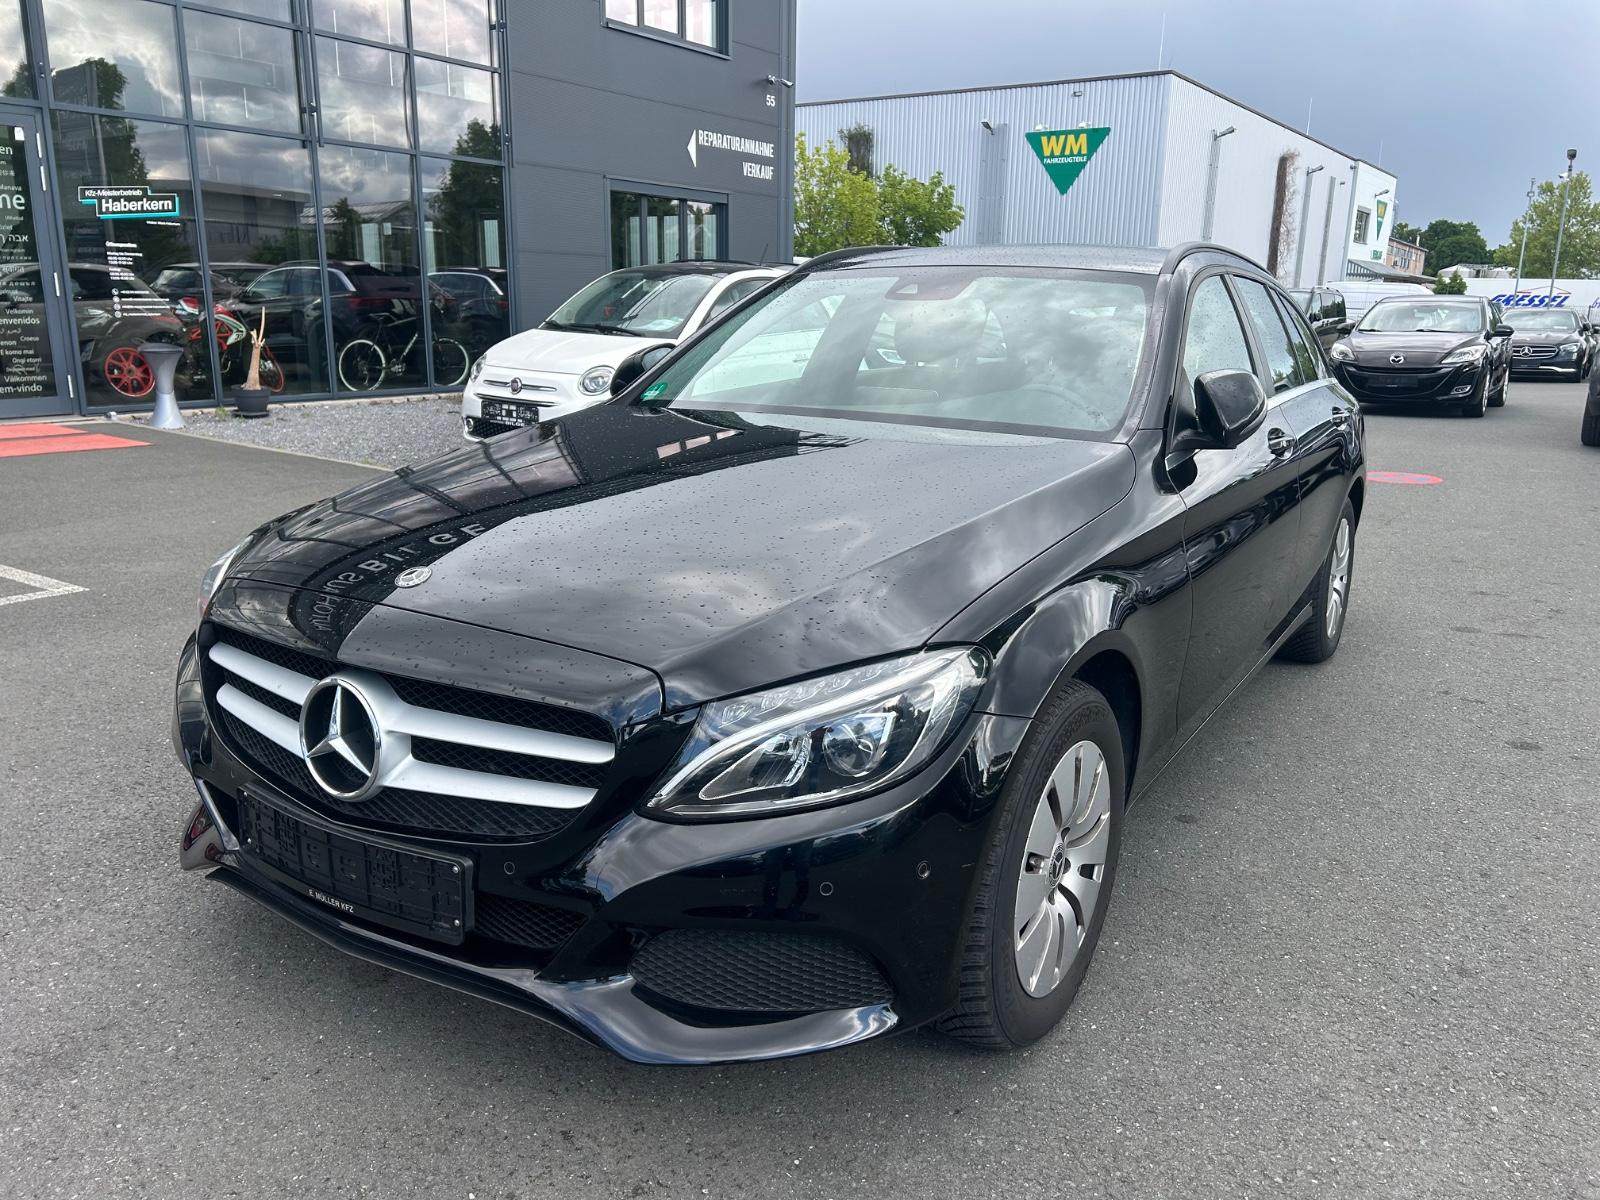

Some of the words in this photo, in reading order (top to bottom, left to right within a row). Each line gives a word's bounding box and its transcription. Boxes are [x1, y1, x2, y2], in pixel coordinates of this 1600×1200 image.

[766, 94, 776, 107] 55
[698, 129, 774, 158] REPARATURANNAHME
[1041, 133, 1087, 156] WM
[742, 161, 774, 180] VERKAUF
[84, 189, 143, 197] Kfz-Meisterbetrieb
[101, 198, 172, 212] Haberkern
